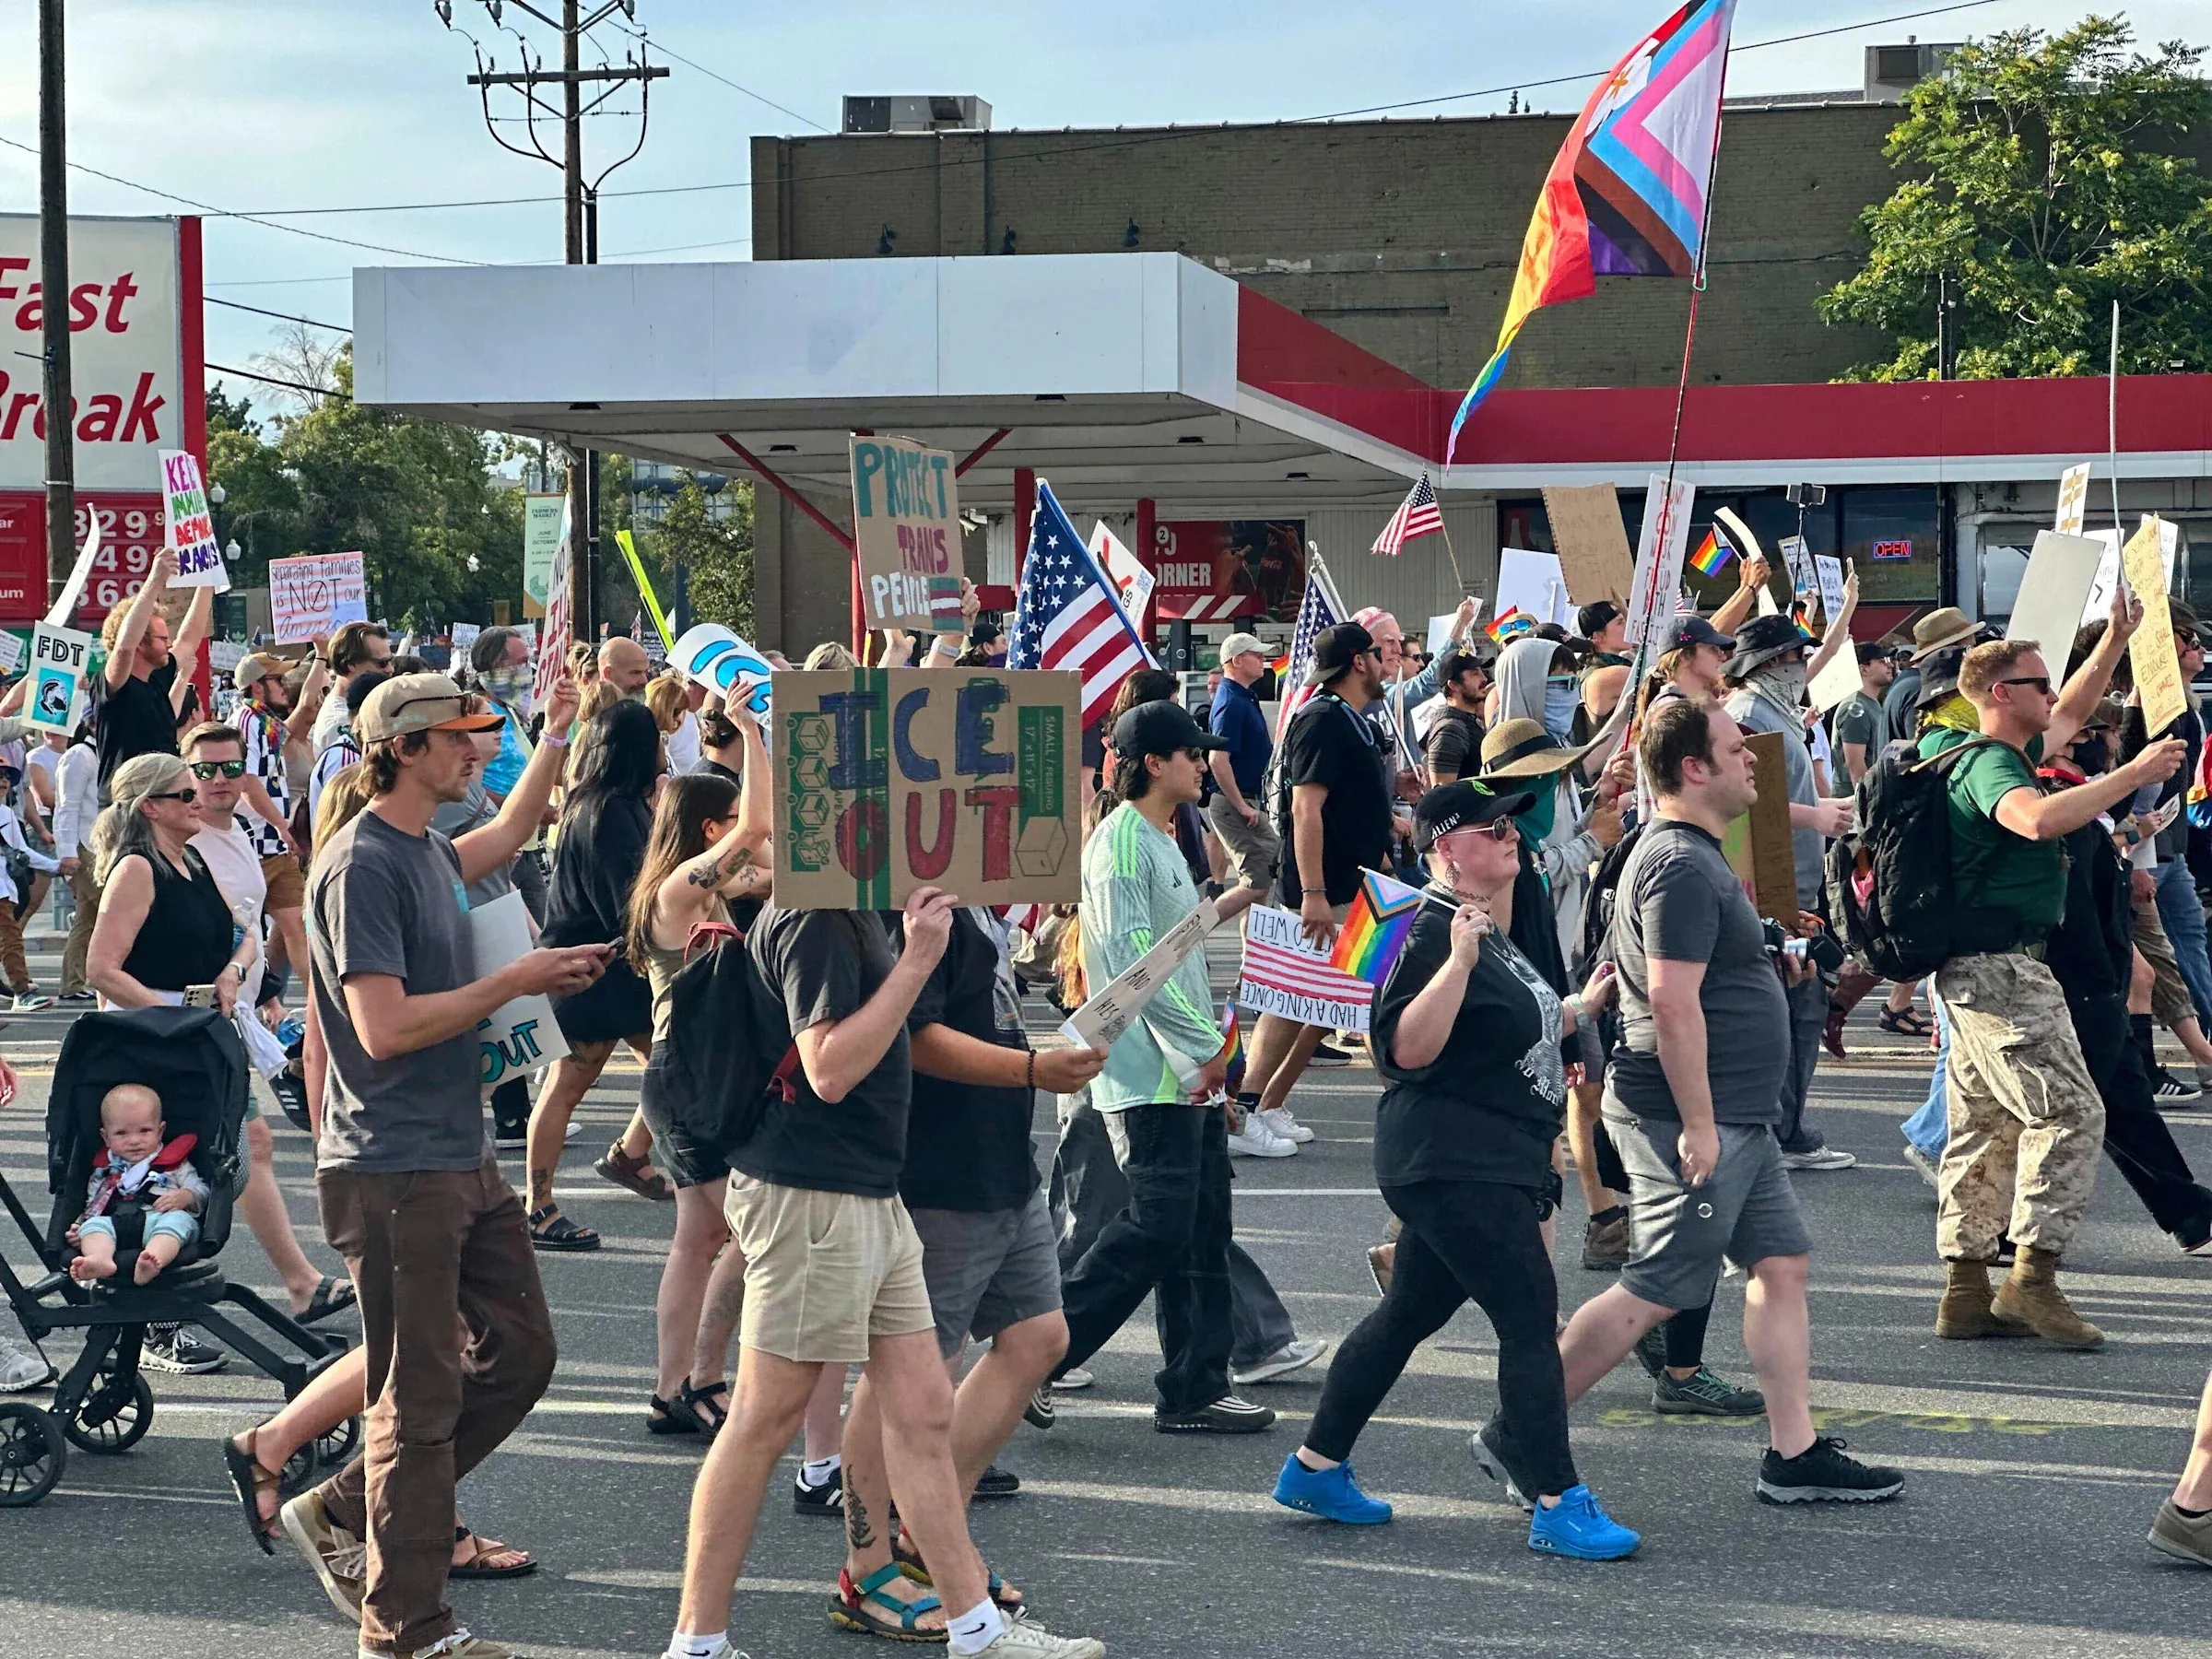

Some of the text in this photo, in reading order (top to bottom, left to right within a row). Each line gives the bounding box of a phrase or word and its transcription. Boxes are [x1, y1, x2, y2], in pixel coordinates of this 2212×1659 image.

[855, 442, 948, 519] PROTECT
[897, 524, 948, 574] TRANS
[1876, 542, 1911, 556] OPEN
[320, 557, 360, 578] families
[1155, 562, 1211, 586] ORNER
[276, 594, 285, 608] is
[344, 588, 360, 602] our
[871, 571, 931, 618] PEOPLE
[37, 635, 84, 666] FDT
[818, 684, 1015, 790] ICE
[1045, 715, 1056, 756] SMALL
[835, 786, 1026, 882] OUT
[1252, 911, 1288, 942] WELL
[1241, 982, 1276, 1008] ONCE
[1277, 994, 1314, 1021] KING
[1315, 1000, 1325, 1022] A
[1330, 1004, 1358, 1028] HAD
